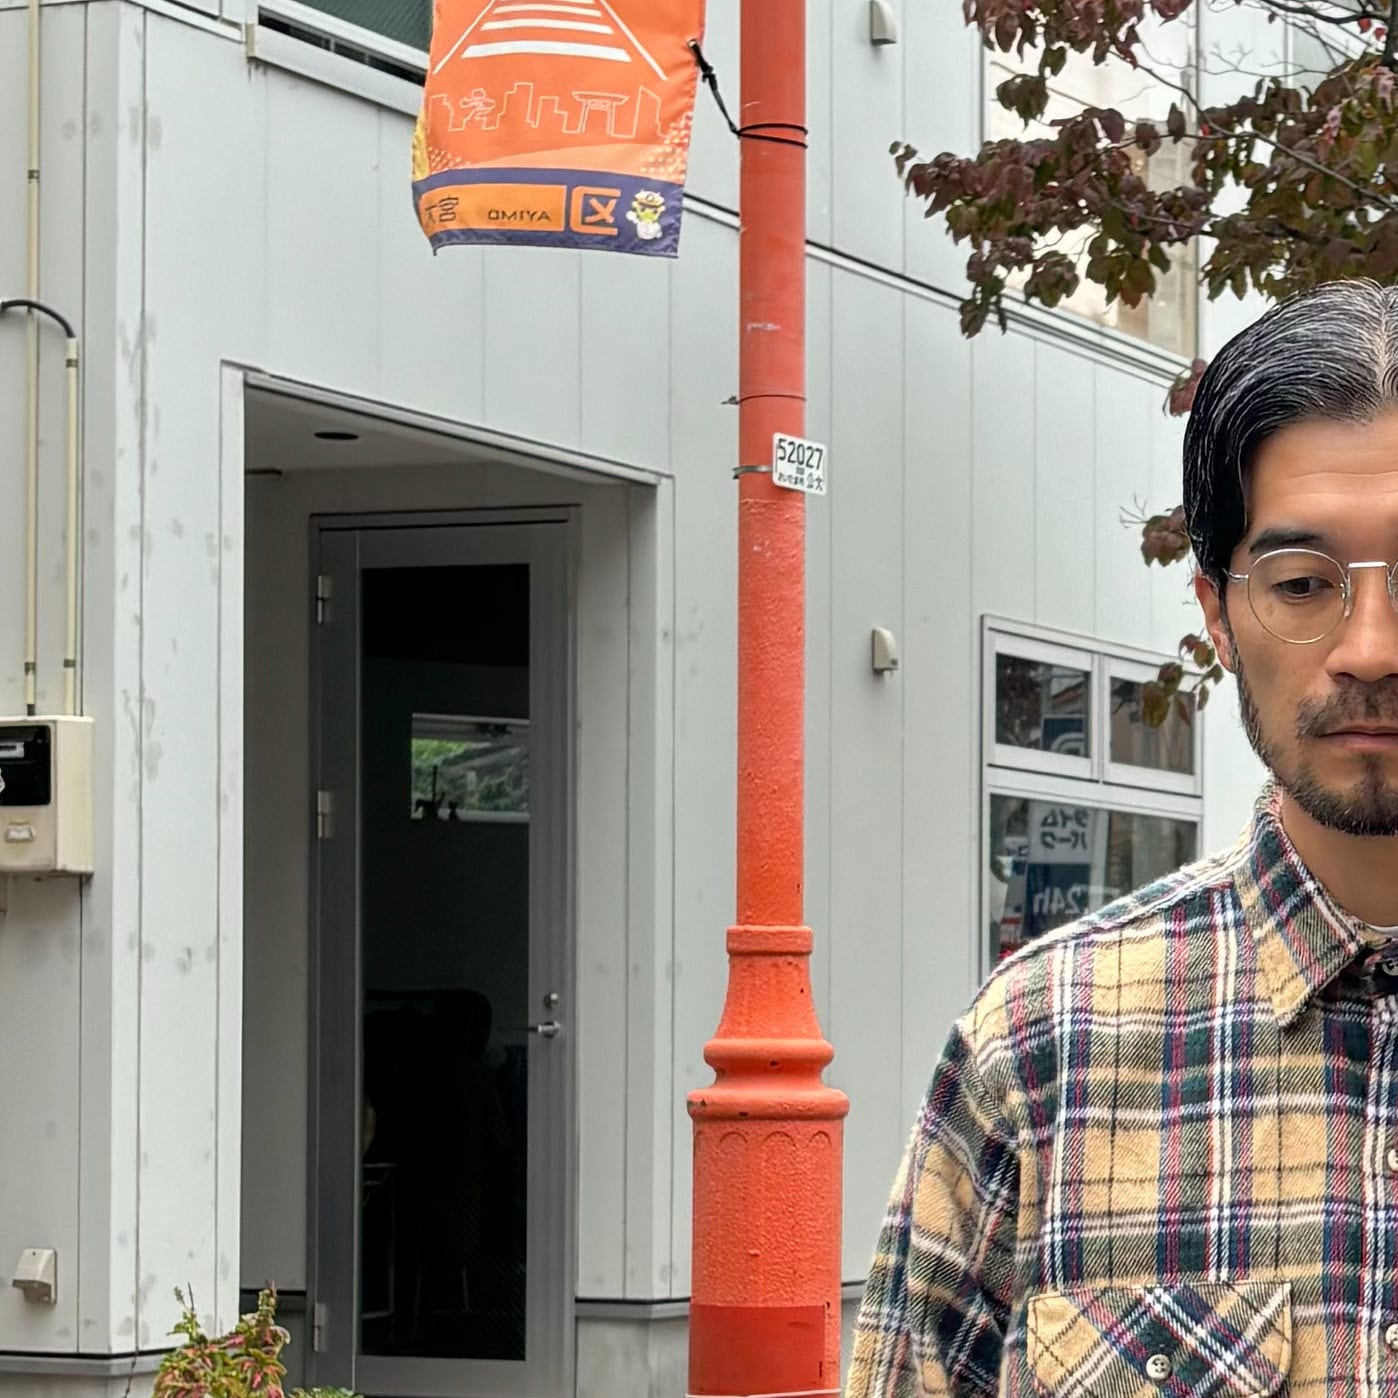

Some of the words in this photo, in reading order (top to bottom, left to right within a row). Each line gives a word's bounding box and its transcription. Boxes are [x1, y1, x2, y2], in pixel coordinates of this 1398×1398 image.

[487, 209, 552, 222] OMIYA
[569, 185, 622, 236] 区
[777, 437, 824, 471] 52027
